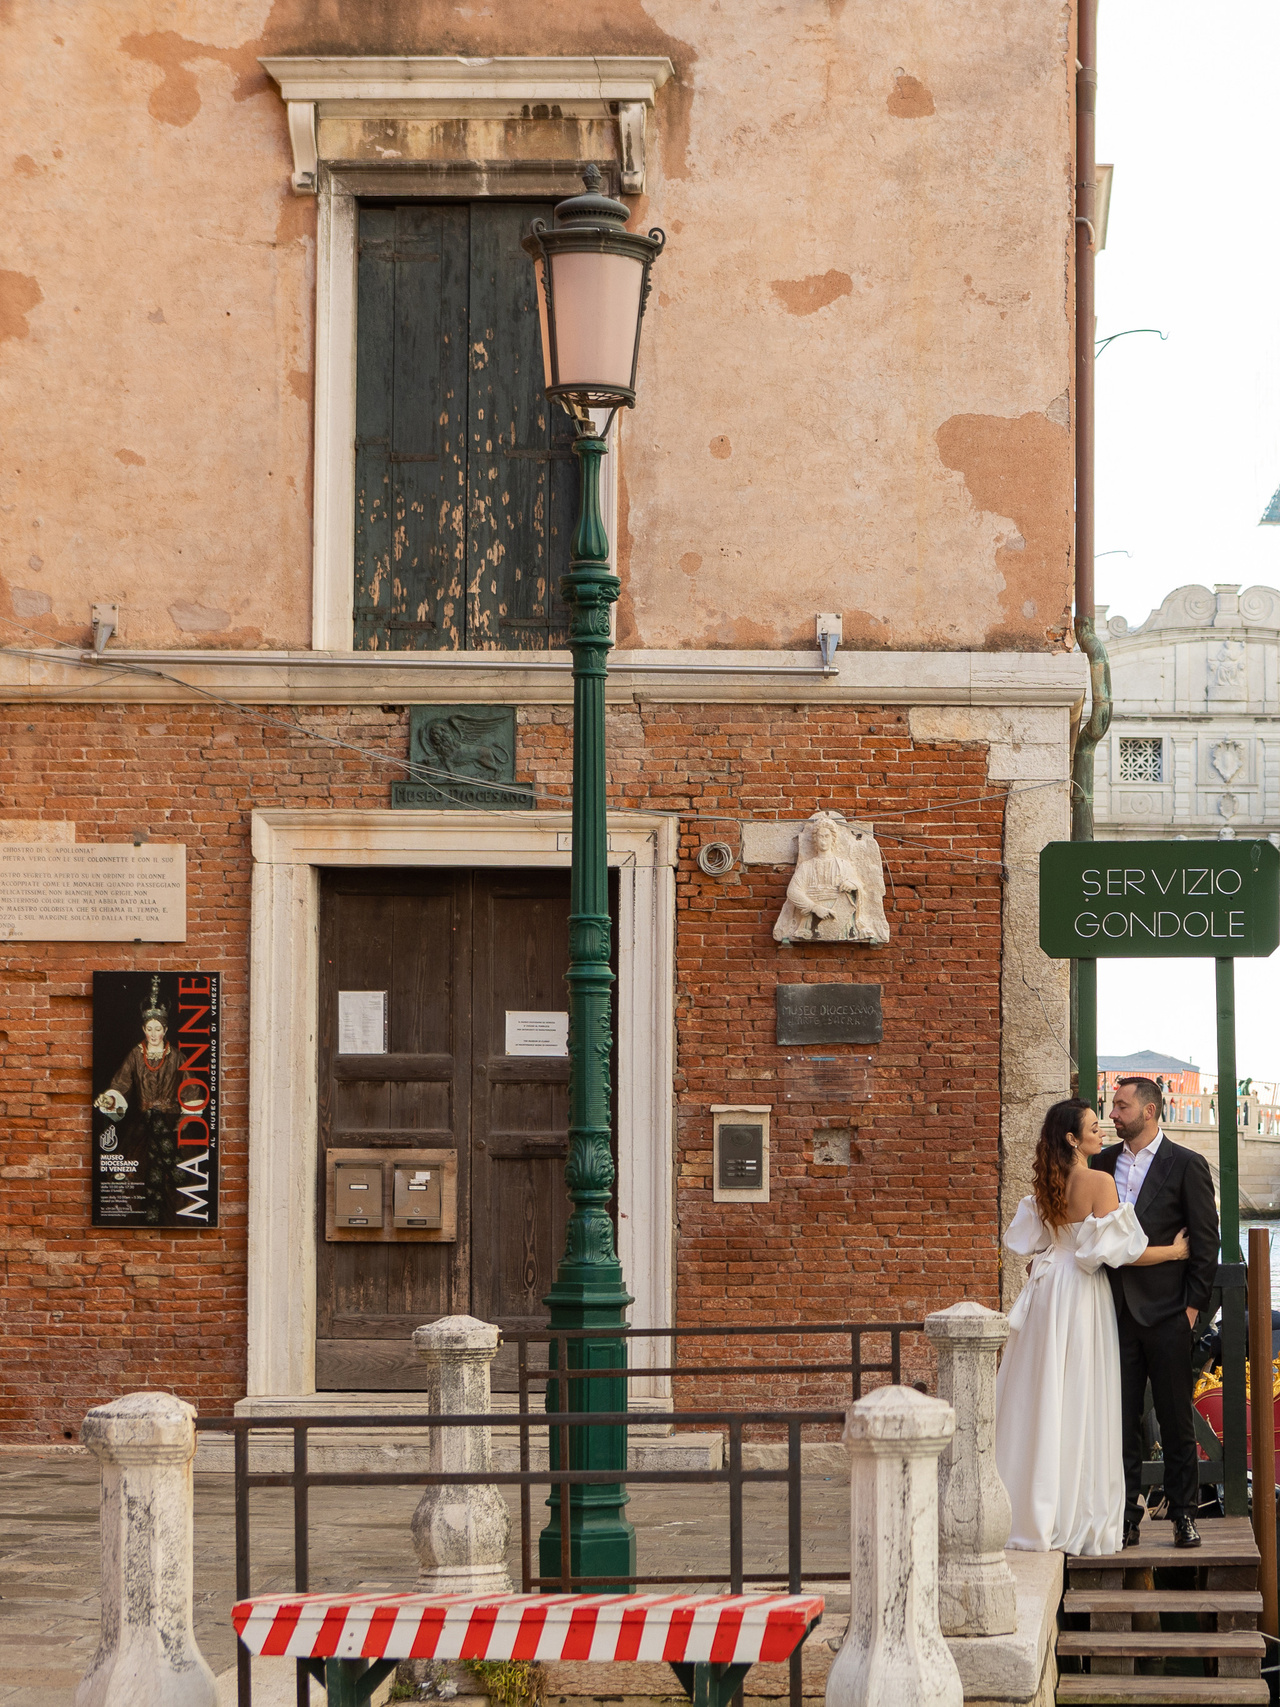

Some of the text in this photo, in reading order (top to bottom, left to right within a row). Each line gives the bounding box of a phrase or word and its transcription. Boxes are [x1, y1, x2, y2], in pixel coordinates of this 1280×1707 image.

[396, 787, 442, 802] MUSEO
[1082, 869, 1242, 896] SERVIZIO
[1074, 911, 1245, 938] GONDOLE
[211, 1023, 217, 1032] DI
[176, 976, 210, 1222] MADONNE
[210, 1136, 216, 1147] AL
